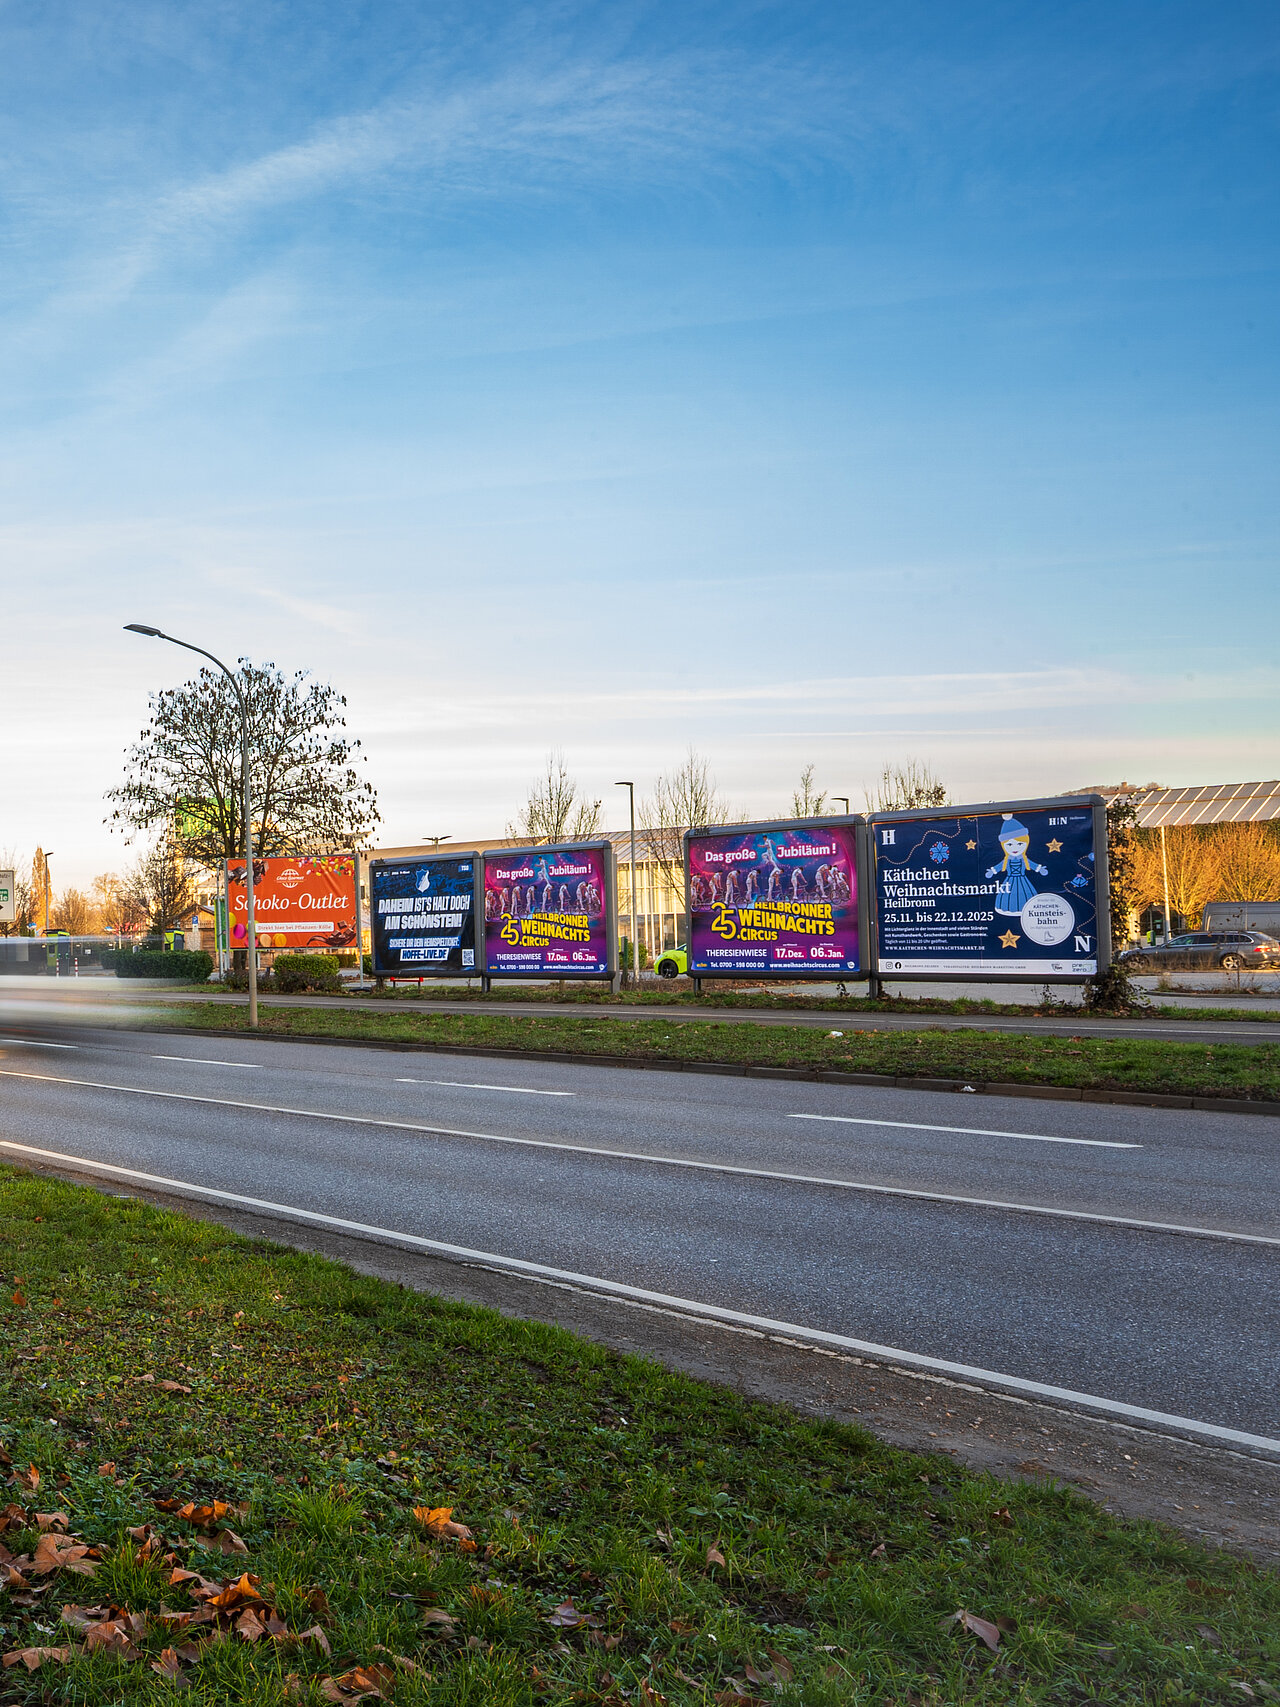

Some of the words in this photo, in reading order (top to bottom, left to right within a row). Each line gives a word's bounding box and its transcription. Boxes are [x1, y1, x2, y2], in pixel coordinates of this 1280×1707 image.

[881, 829, 896, 845] H
[705, 851, 724, 862] Das
[724, 848, 757, 864] große
[777, 845, 830, 858] Jubiläum
[496, 869, 511, 879] Das
[511, 868, 534, 880] große
[549, 864, 587, 876] Jubiläum
[883, 867, 950, 882] Käthchen
[883, 880, 1011, 897] Weihnachtsmarkt
[378, 897, 414, 914] DAHEIM
[432, 895, 450, 911] HALT
[449, 894, 470, 910] DOCH
[754, 901, 832, 919] HEILBRONNER
[884, 898, 936, 908] Heilbronn
[384, 915, 400, 930] AM
[401, 911, 462, 929] SCHÖNSTEN!
[532, 912, 589, 929] HEILBRONNER
[884, 912, 914, 922] 25.11.
[916, 911, 933, 922] bis
[934, 911, 994, 922] 22.12.2025
[1028, 909, 1067, 917] Kunsteis-
[1037, 917, 1058, 925] bahn
[520, 919, 591, 942] WEIHNACHTS
[738, 909, 835, 936] WEIHNACHTS
[1073, 935, 1091, 952] N
[402, 949, 447, 959] HOFFE-LIVE.DE
[706, 949, 767, 957] THERESIENWIESE
